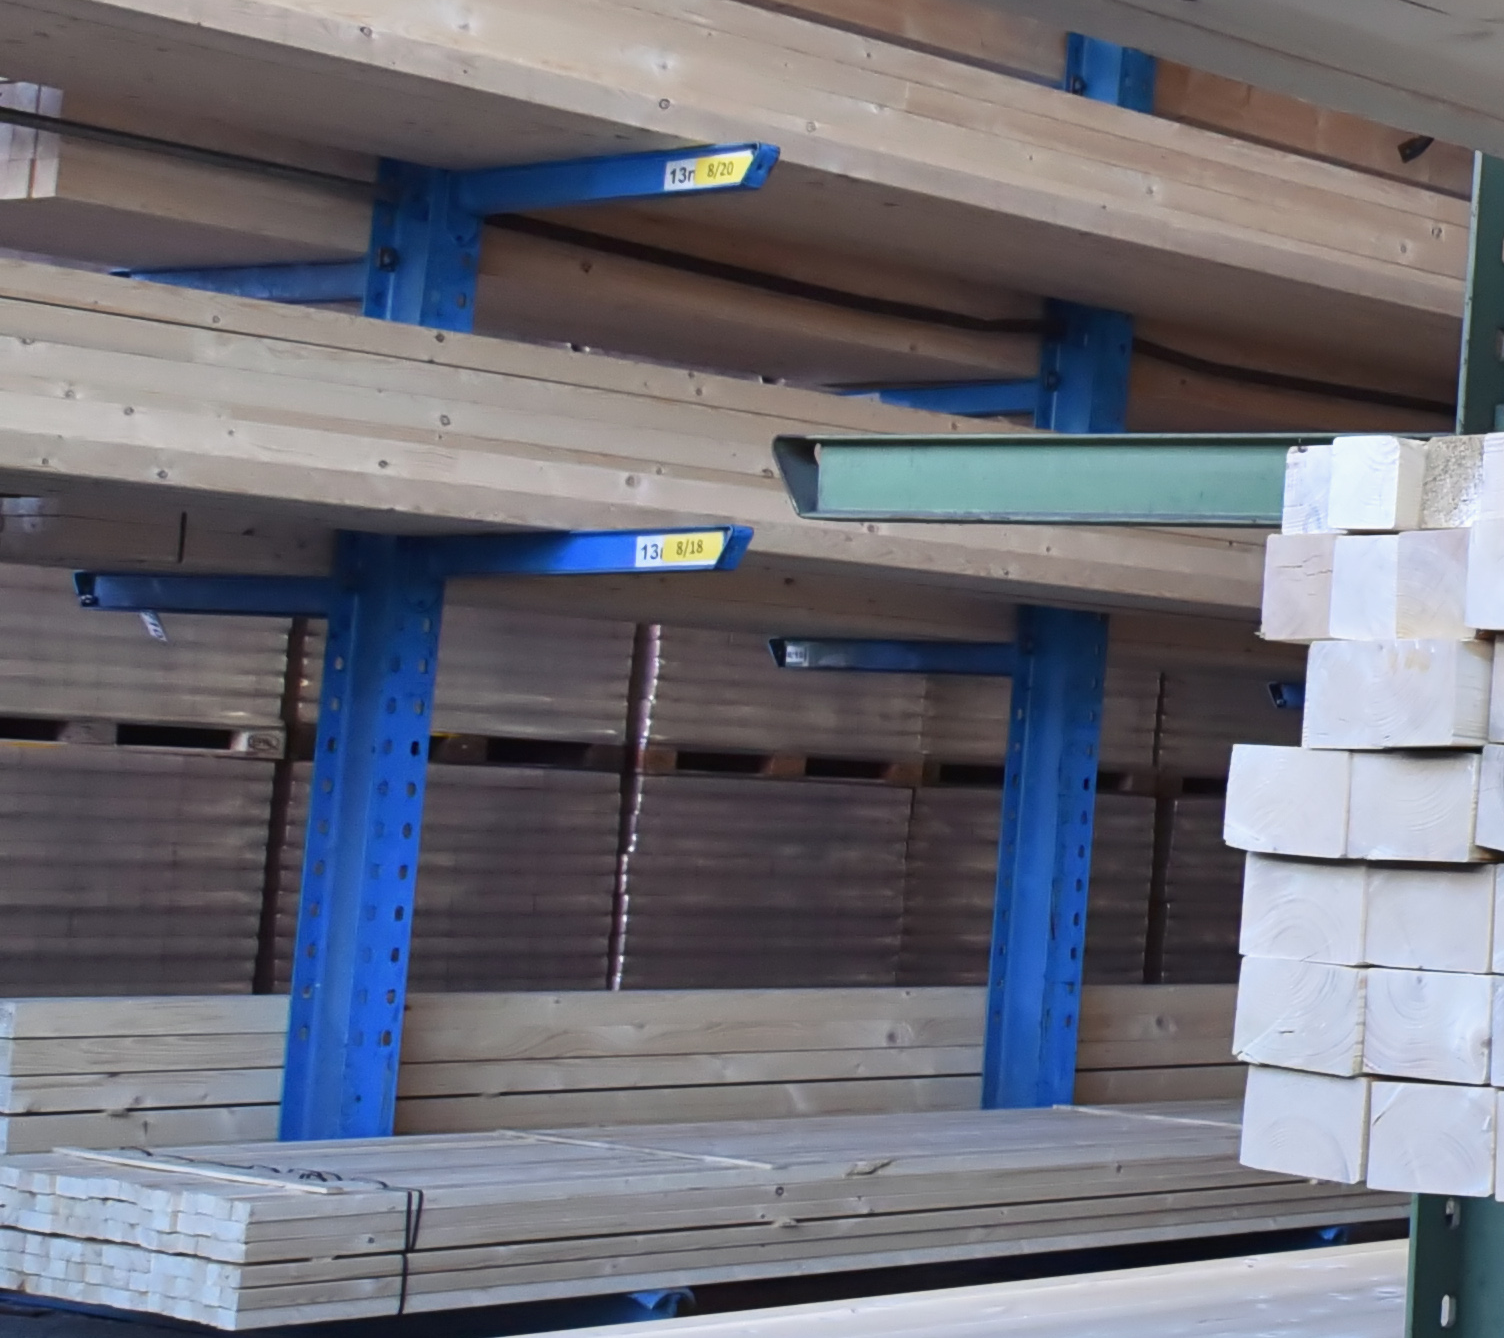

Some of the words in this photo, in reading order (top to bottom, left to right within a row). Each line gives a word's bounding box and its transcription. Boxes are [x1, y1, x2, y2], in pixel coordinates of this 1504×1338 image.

[707, 160, 735, 179] 8/20
[641, 543, 664, 560] 13
[676, 539, 703, 558] 8/18
